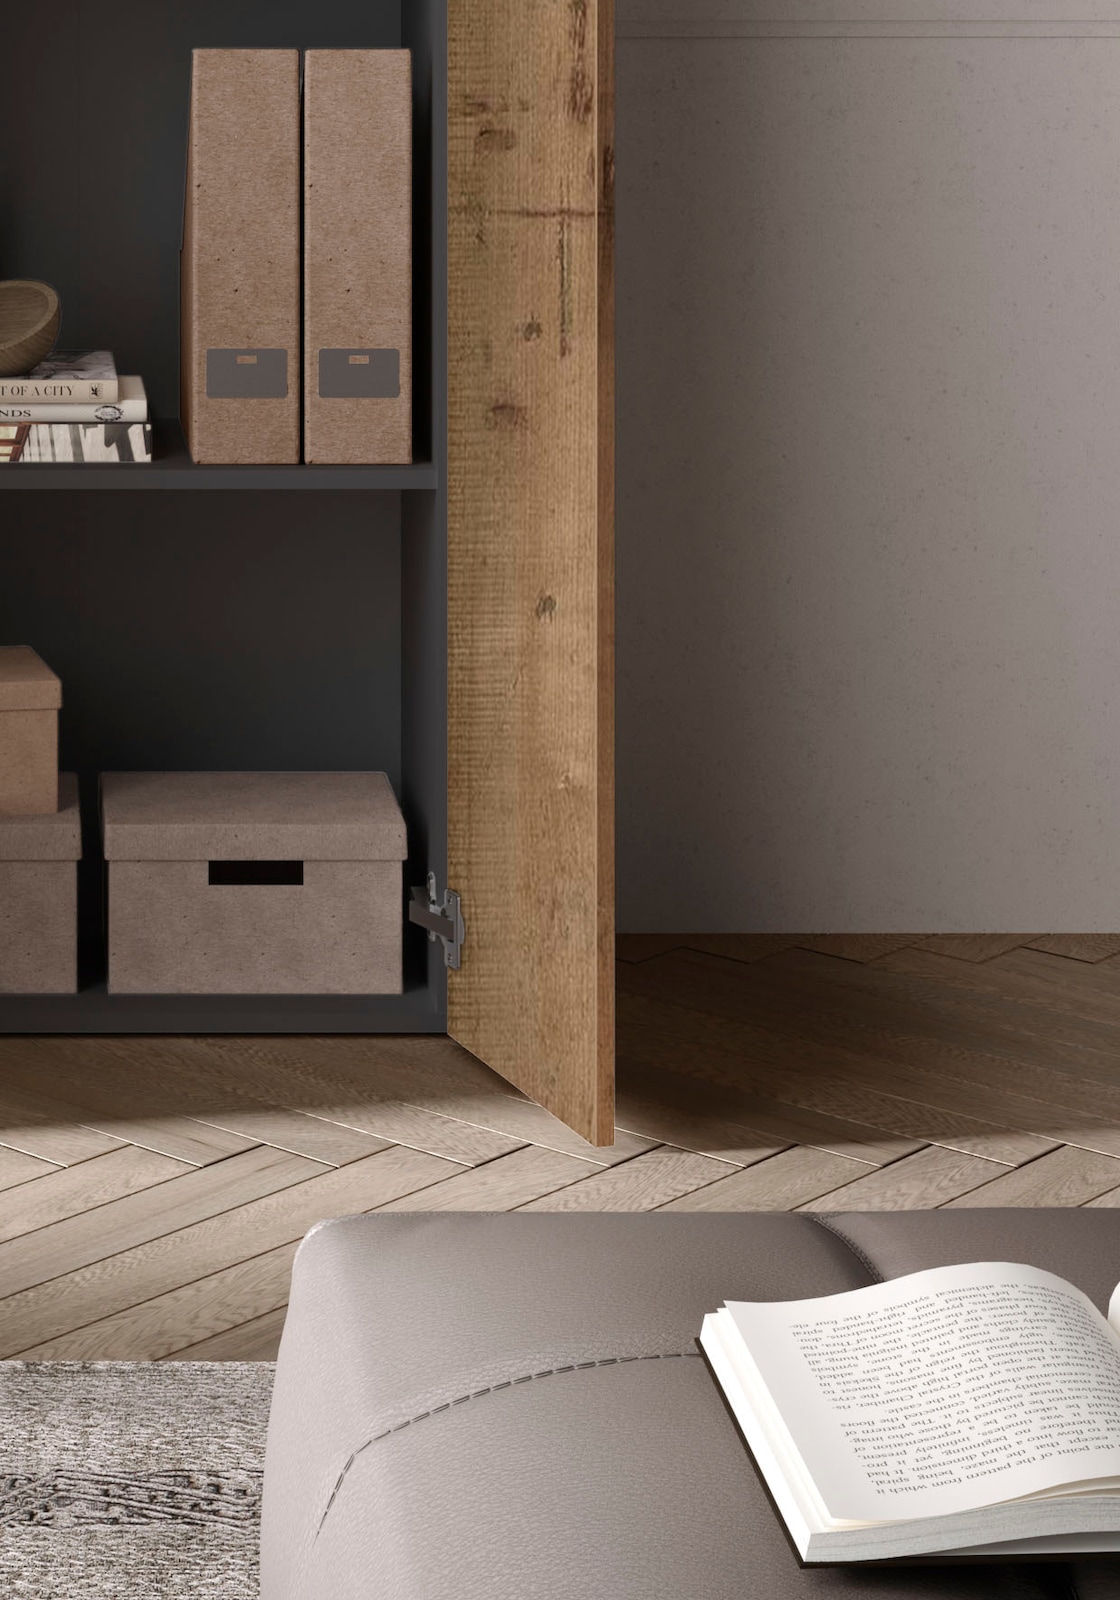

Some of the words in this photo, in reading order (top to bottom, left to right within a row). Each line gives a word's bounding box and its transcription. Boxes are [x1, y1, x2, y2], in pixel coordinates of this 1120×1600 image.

[11, 385, 27, 397] OF
[31, 385, 40, 397] A
[43, 385, 75, 397] CITY
[884, 1296, 930, 1312] symbols
[833, 1312, 906, 1333] right-handed
[792, 1329, 823, 1337] spiral
[871, 1329, 903, 1340] moon
[803, 1343, 877, 1359] nine-pointed
[862, 1344, 908, 1358] insignia
[899, 1357, 922, 1367] had
[811, 1363, 858, 1373] symbols
[862, 1365, 891, 1374] been
[836, 1376, 880, 1386] Skeksis
[922, 1376, 950, 1386] high
[964, 1377, 1022, 1394] chambers
[1015, 1382, 1051, 1390] subtly
[841, 1384, 881, 1394] honest
[884, 1384, 918, 1395] above
[918, 1382, 961, 1398] Crystal
[926, 1397, 945, 1405] the
[974, 1394, 1023, 1410] subjects
[904, 1401, 965, 1420] connected
[974, 1401, 1025, 1421] pictured
[911, 1419, 936, 1427] The
[983, 1419, 998, 1427] be
[862, 1423, 906, 1434] pattern
[918, 1423, 951, 1434] those
[1015, 1428, 1031, 1436] no
[873, 1430, 961, 1450] representation
[887, 1432, 914, 1440] who
[1027, 1433, 1053, 1442] into
[916, 1437, 970, 1453] infinitely
[981, 1444, 1012, 1457] third
[1006, 1449, 1026, 1459] the
[915, 1454, 933, 1463] yet
[1016, 1456, 1036, 1466] the
[1041, 1452, 1053, 1460] of
[917, 1470, 953, 1480] being
[966, 1462, 1011, 1479] pattern
[932, 1477, 962, 1487] from
[889, 1485, 928, 1494] which
